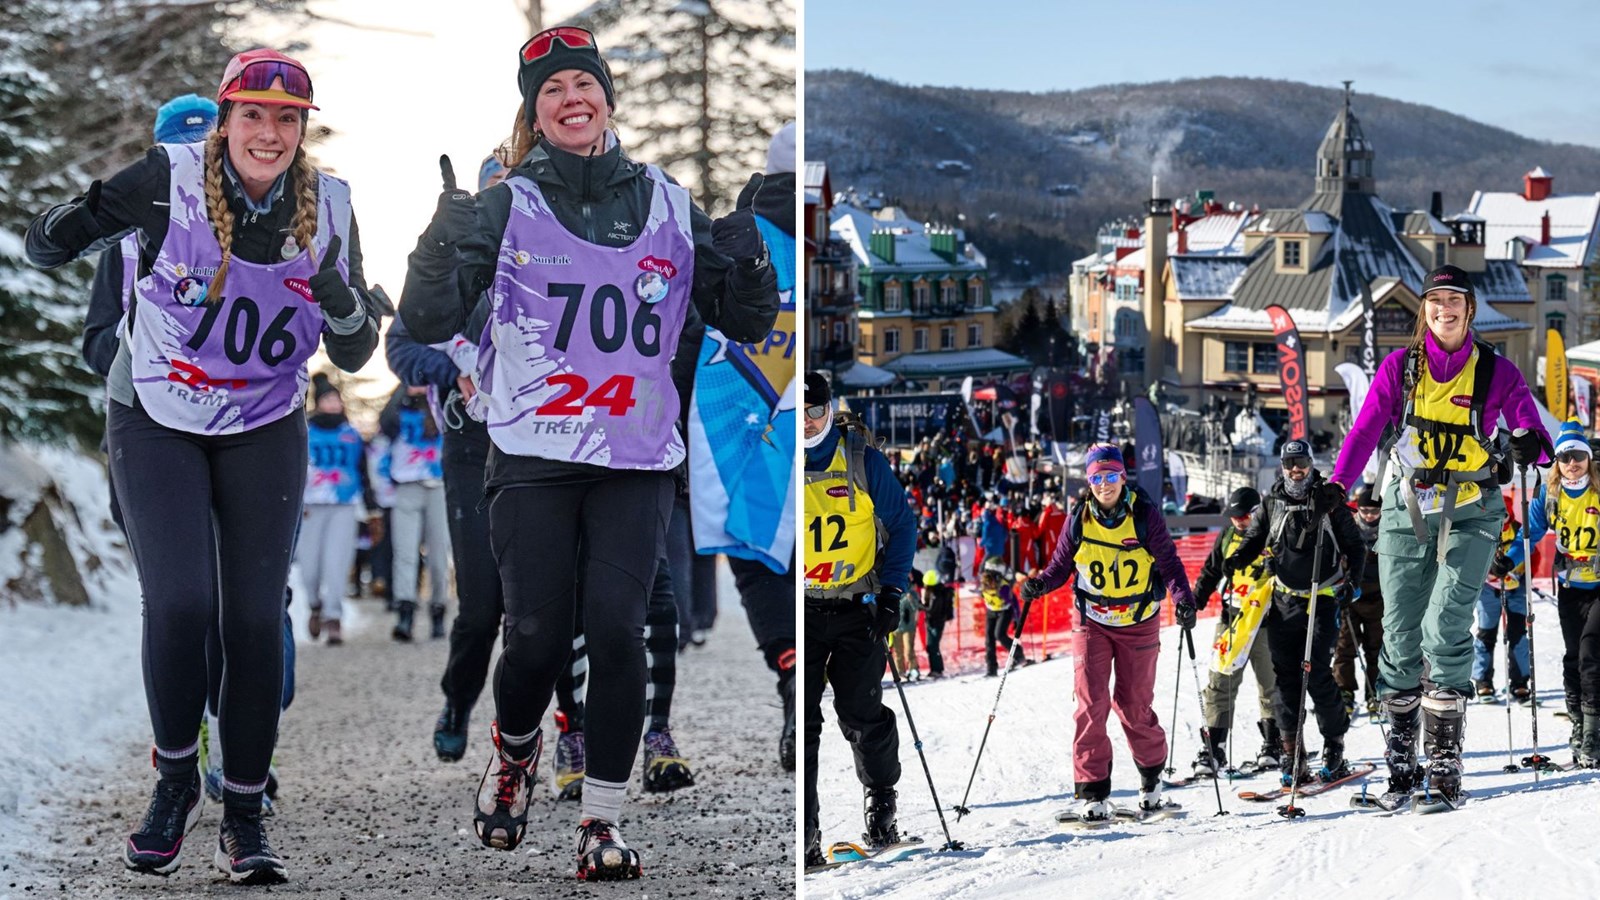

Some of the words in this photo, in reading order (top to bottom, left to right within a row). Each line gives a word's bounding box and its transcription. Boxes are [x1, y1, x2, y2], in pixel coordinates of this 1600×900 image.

[532, 254, 550, 264] Sun
[551, 254, 572, 265] Life
[185, 296, 298, 367] 706
[547, 282, 662, 357] 706
[1560, 526, 1598, 551] 812
[804, 559, 856, 583] 4h
[1089, 557, 1139, 590] 812
